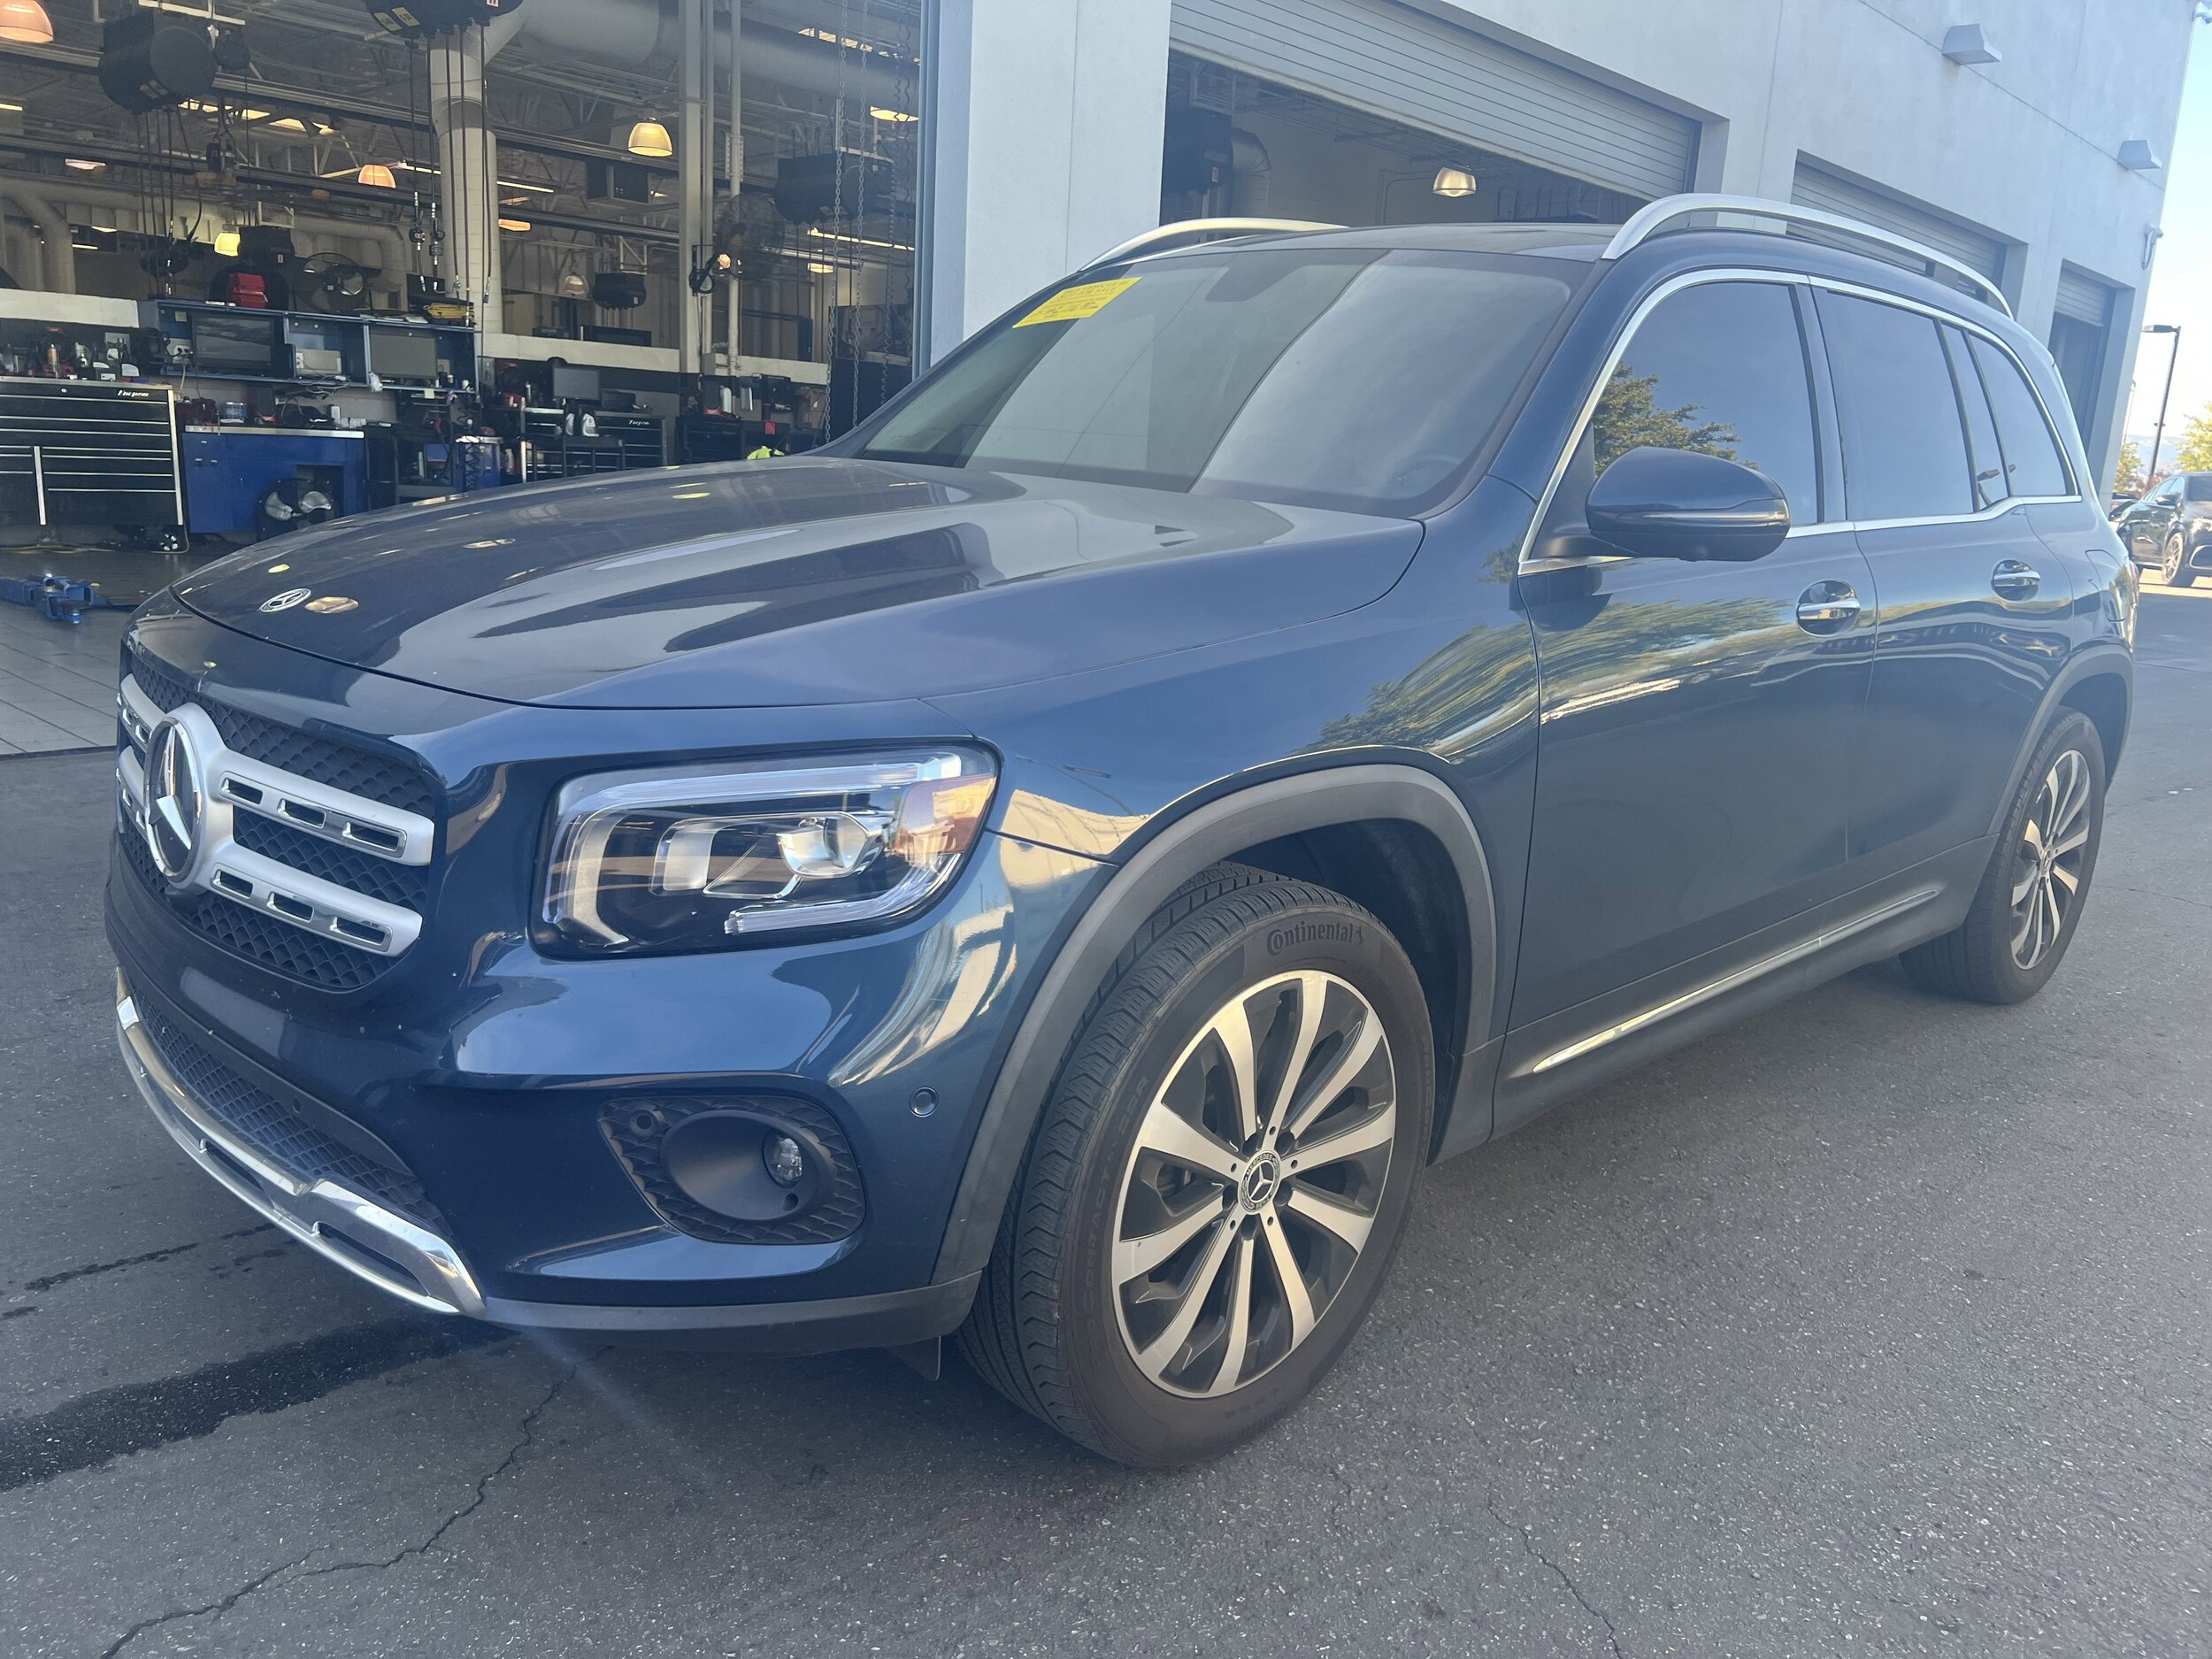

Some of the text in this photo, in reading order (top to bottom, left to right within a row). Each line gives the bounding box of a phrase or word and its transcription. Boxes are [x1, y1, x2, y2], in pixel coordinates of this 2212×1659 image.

[1266, 921, 1354, 956] Continental
[1246, 1152, 1273, 1175] MERCEDES
[1255, 1194, 1272, 1210] BENZ
